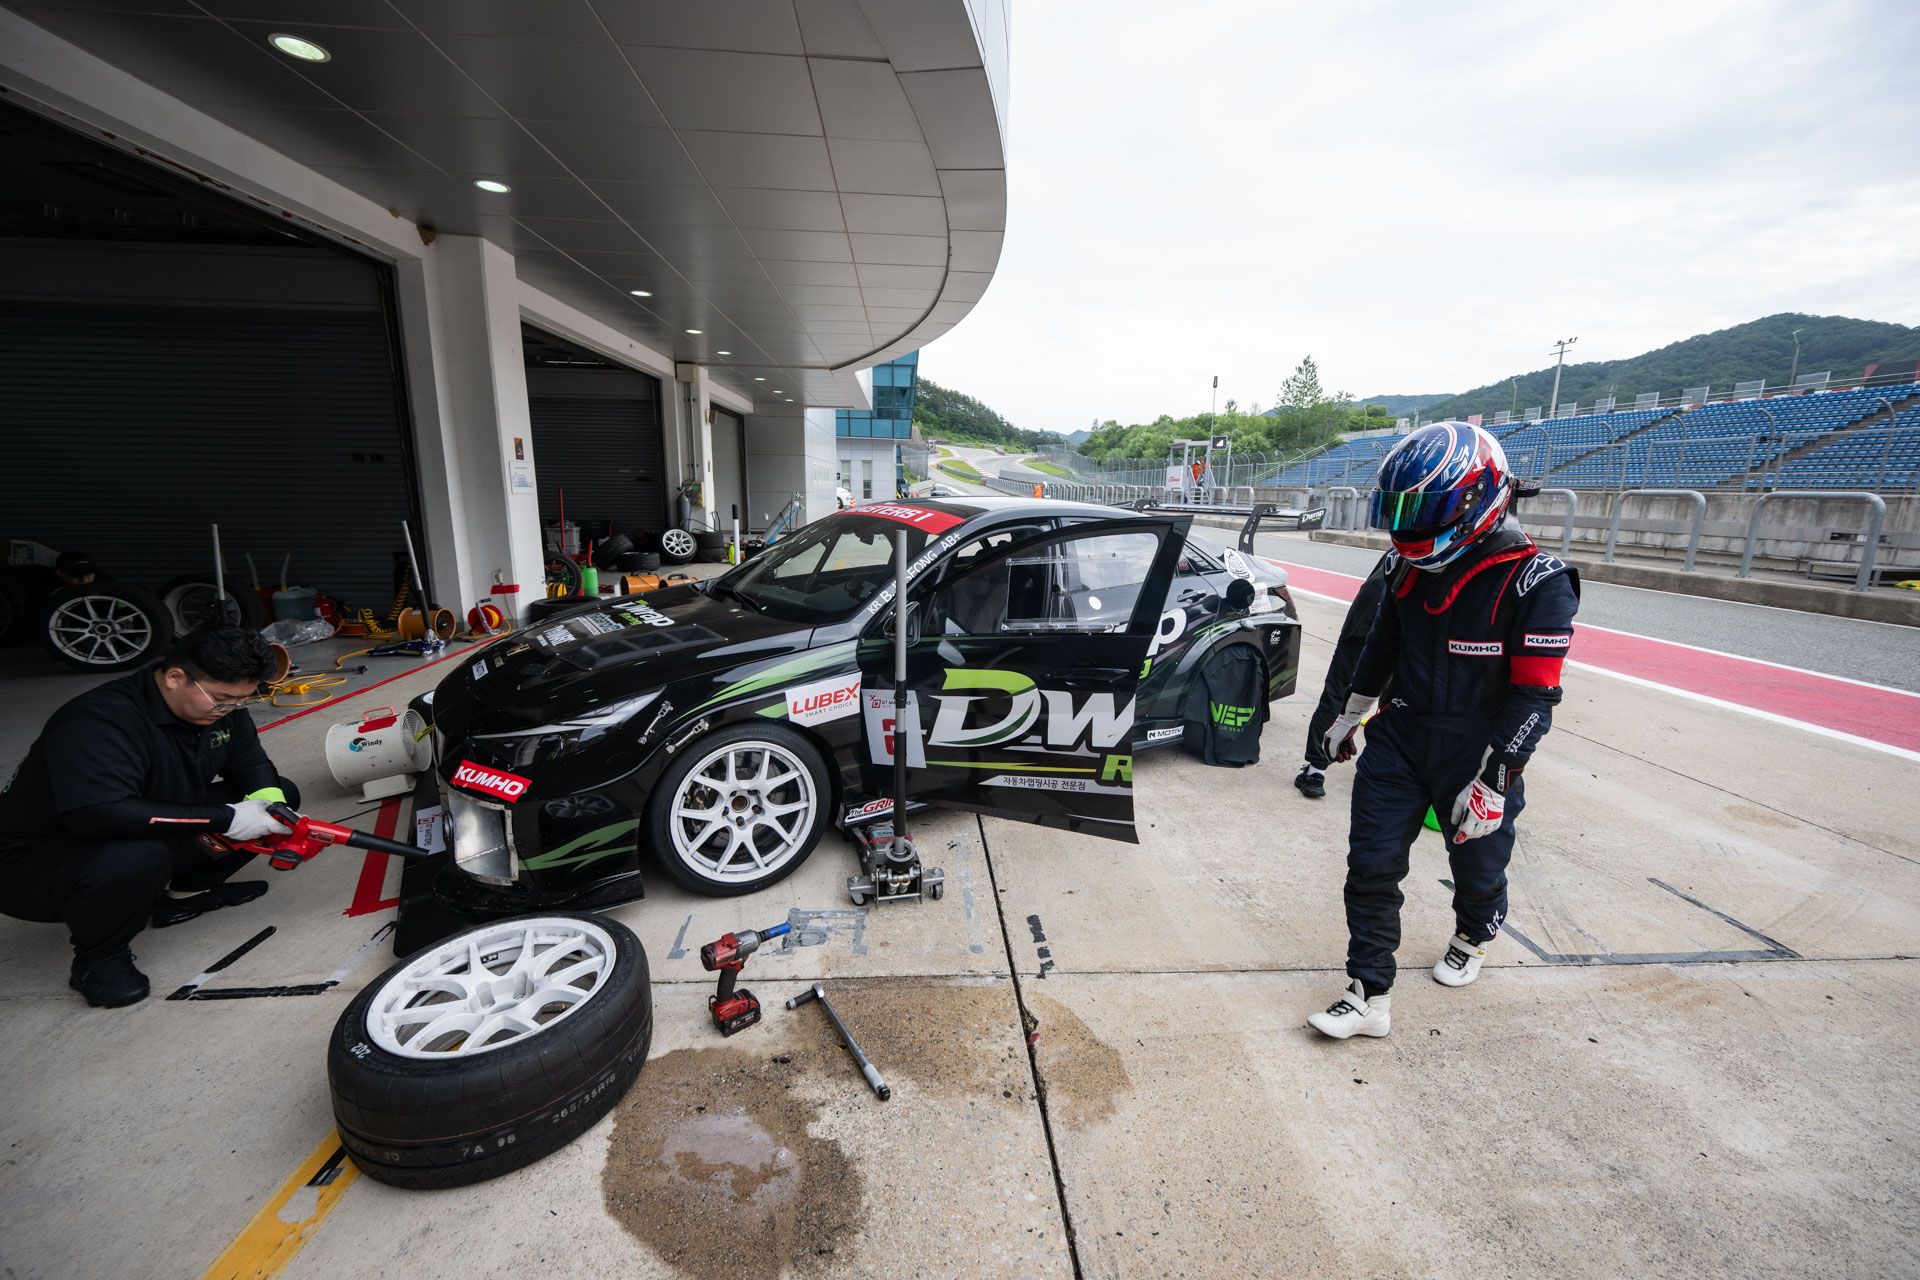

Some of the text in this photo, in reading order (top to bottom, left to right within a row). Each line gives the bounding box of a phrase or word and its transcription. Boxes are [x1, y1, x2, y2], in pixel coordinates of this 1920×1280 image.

[867, 600, 882, 614] KR
[940, 532, 961, 552] AB+
[1450, 643, 1500, 653] KUMHO
[1526, 637, 1569, 645] KUMHO
[793, 681, 861, 715] LUBEX
[805, 701, 853, 718] SMART CHOICE
[361, 739, 383, 748] Windy
[455, 765, 524, 796] KUMHO
[1003, 776, 1087, 791] 자동차랩핑시공 전문점
